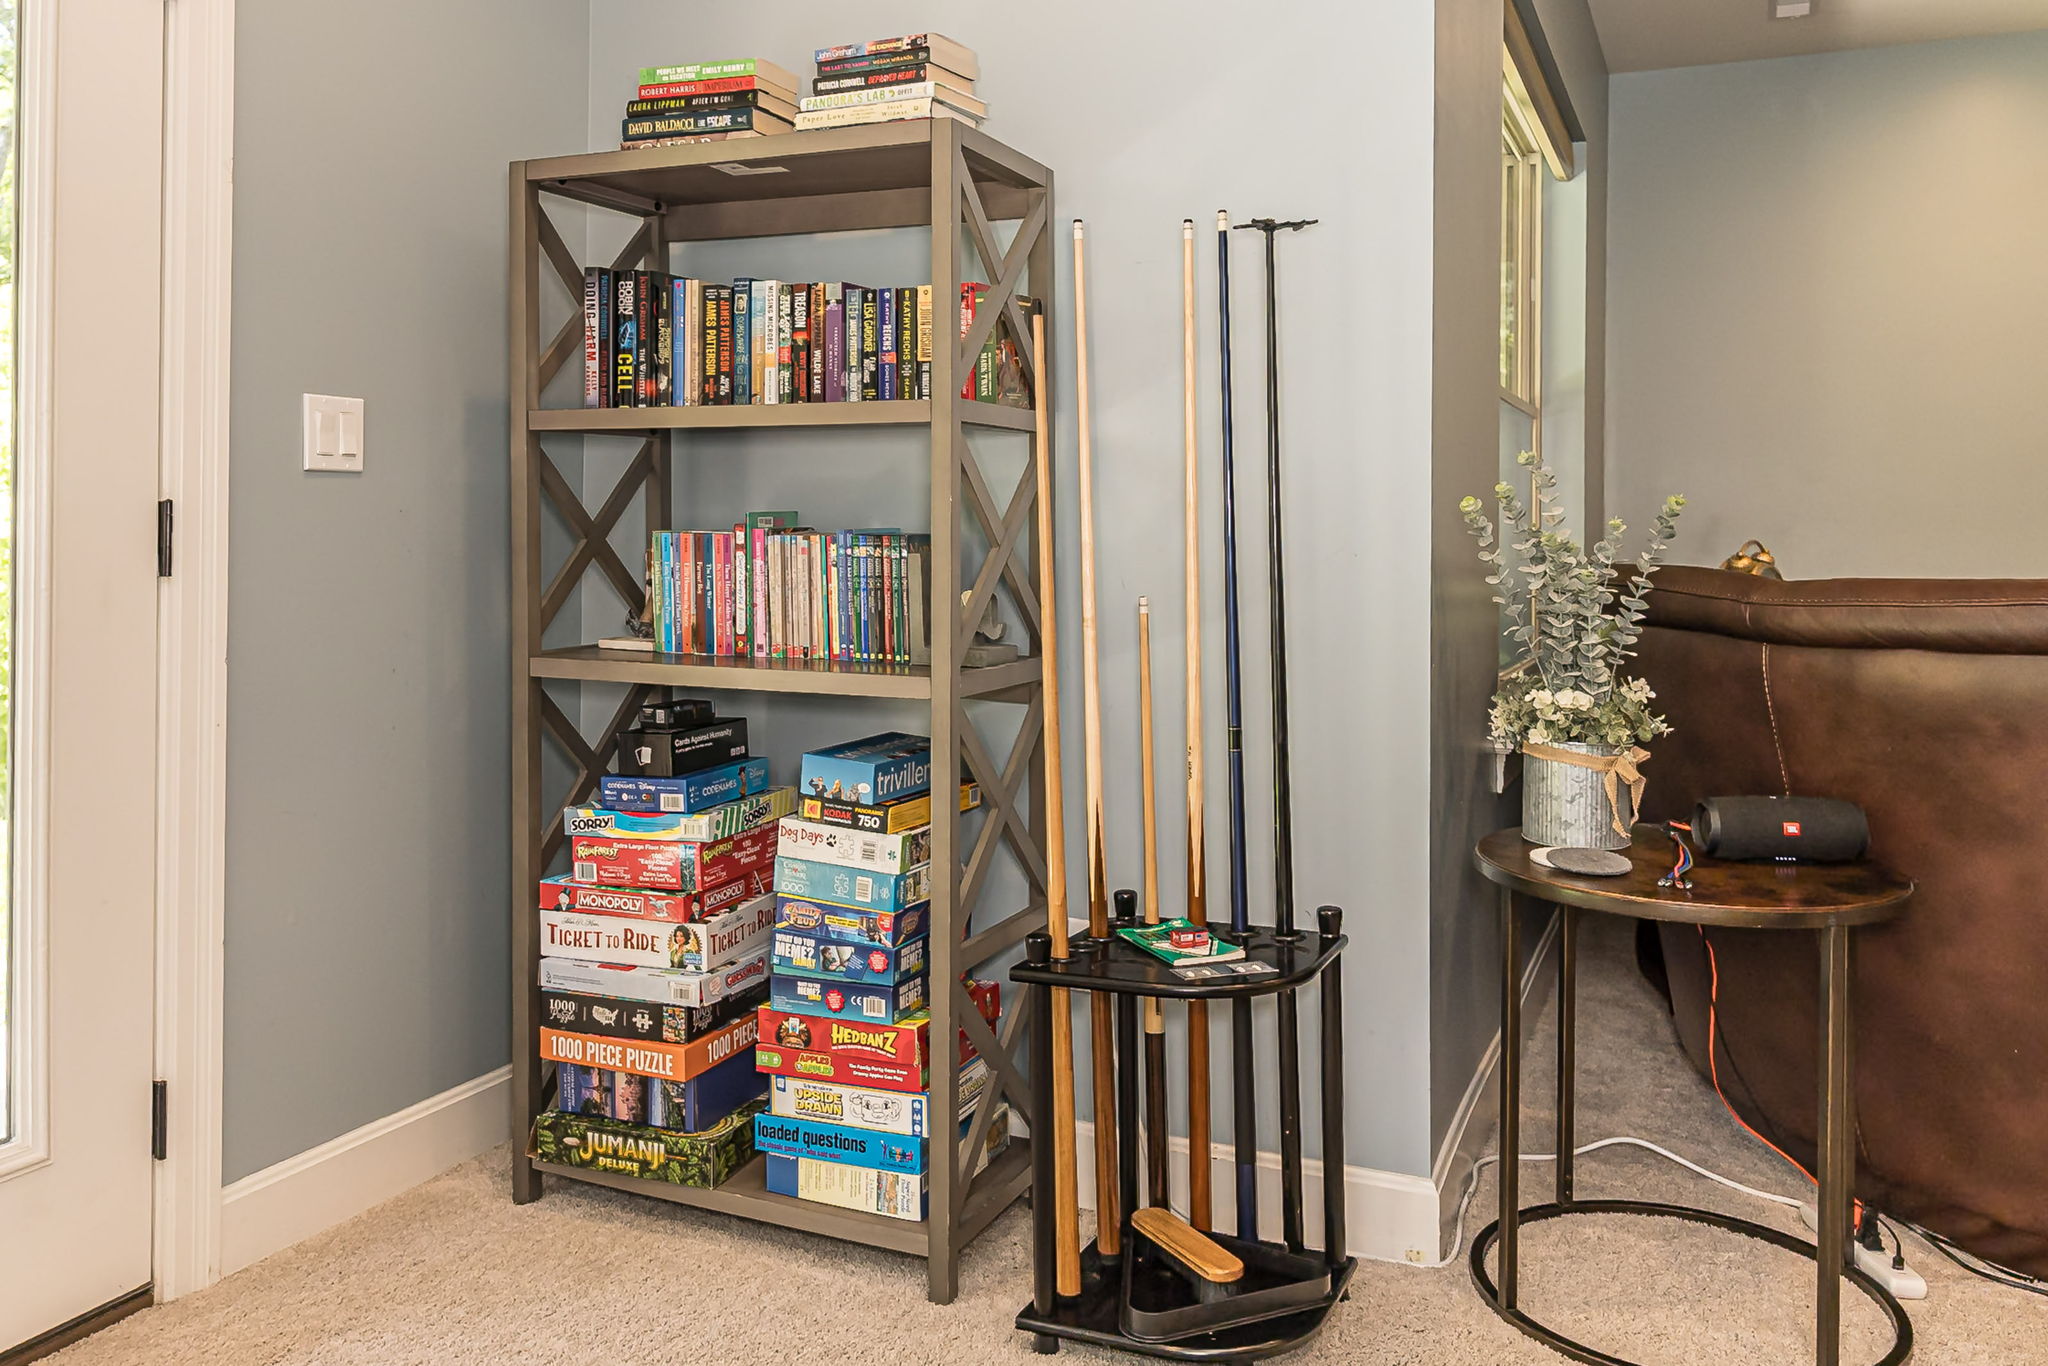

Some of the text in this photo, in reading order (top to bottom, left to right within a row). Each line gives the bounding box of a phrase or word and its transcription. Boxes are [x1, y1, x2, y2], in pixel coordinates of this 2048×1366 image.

[702, 64, 745, 74] EMILY HENRY
[898, 70, 917, 80] HEART
[641, 85, 695, 96] ROBERT HARRIS
[817, 81, 839, 90] PATRICIA
[629, 99, 685, 112] LAURA LIPPMAN
[692, 97, 708, 105] AFTER
[806, 90, 886, 110] PANDORA'S LAB
[629, 118, 694, 135] DAVID BALDACCI
[707, 115, 732, 128] ESCAPE
[625, 281, 634, 315] ROBIN
[814, 289, 822, 313] LAURA
[639, 276, 648, 341] JOHN GRISHAM
[794, 291, 806, 328] TREASON
[586, 282, 597, 361] DOING HARM
[864, 303, 874, 352] LISA GARDNER
[706, 300, 717, 375] JAMES PATTERSON
[720, 300, 731, 371] JAMES PATTERSON
[883, 324, 891, 351] REICHS
[849, 336, 857, 367] PATTERSON
[617, 354, 633, 394] CELL
[638, 363, 647, 399] WHISTLER
[813, 350, 822, 394] WILDE LAKE
[674, 728, 732, 747] Cards Against Humanity
[638, 782, 656, 791] Disney
[702, 779, 737, 797] CODENAMES
[744, 802, 772, 825] SORRY!
[824, 809, 852, 819] KODAK
[855, 808, 885, 816] PANORAMIC
[571, 816, 615, 832] SORRY!
[858, 815, 880, 828] 750
[780, 824, 825, 846] Dog Days
[706, 884, 744, 906] MONOPOLY
[782, 883, 804, 893] 1000
[580, 895, 641, 911] MONOPOLY
[785, 903, 821, 919] FAMILY
[790, 913, 816, 926] FEUD
[547, 922, 660, 953] TICKET TO RIDE
[711, 924, 745, 955] TICKET
[748, 924, 756, 936] TO
[775, 933, 793, 942] WHAT
[803, 937, 815, 947] YOU
[774, 941, 815, 960] MEME?
[797, 986, 821, 996] MEME?
[550, 999, 575, 1011] 1000
[550, 1010, 575, 1023] Puzzle
[830, 1023, 898, 1054] HEDBANZ
[550, 1035, 674, 1076] 1000 PIECE PUZZLE
[707, 1034, 732, 1064] 1000
[800, 1054, 831, 1064] APPLES
[803, 1065, 833, 1075] APPLES
[794, 1087, 842, 1103] UPSIDE
[795, 1100, 844, 1116] DRAWN
[758, 1121, 867, 1153] loaded questions
[580, 1131, 666, 1170] JUMANJI
[599, 1157, 640, 1172] DELUXE
